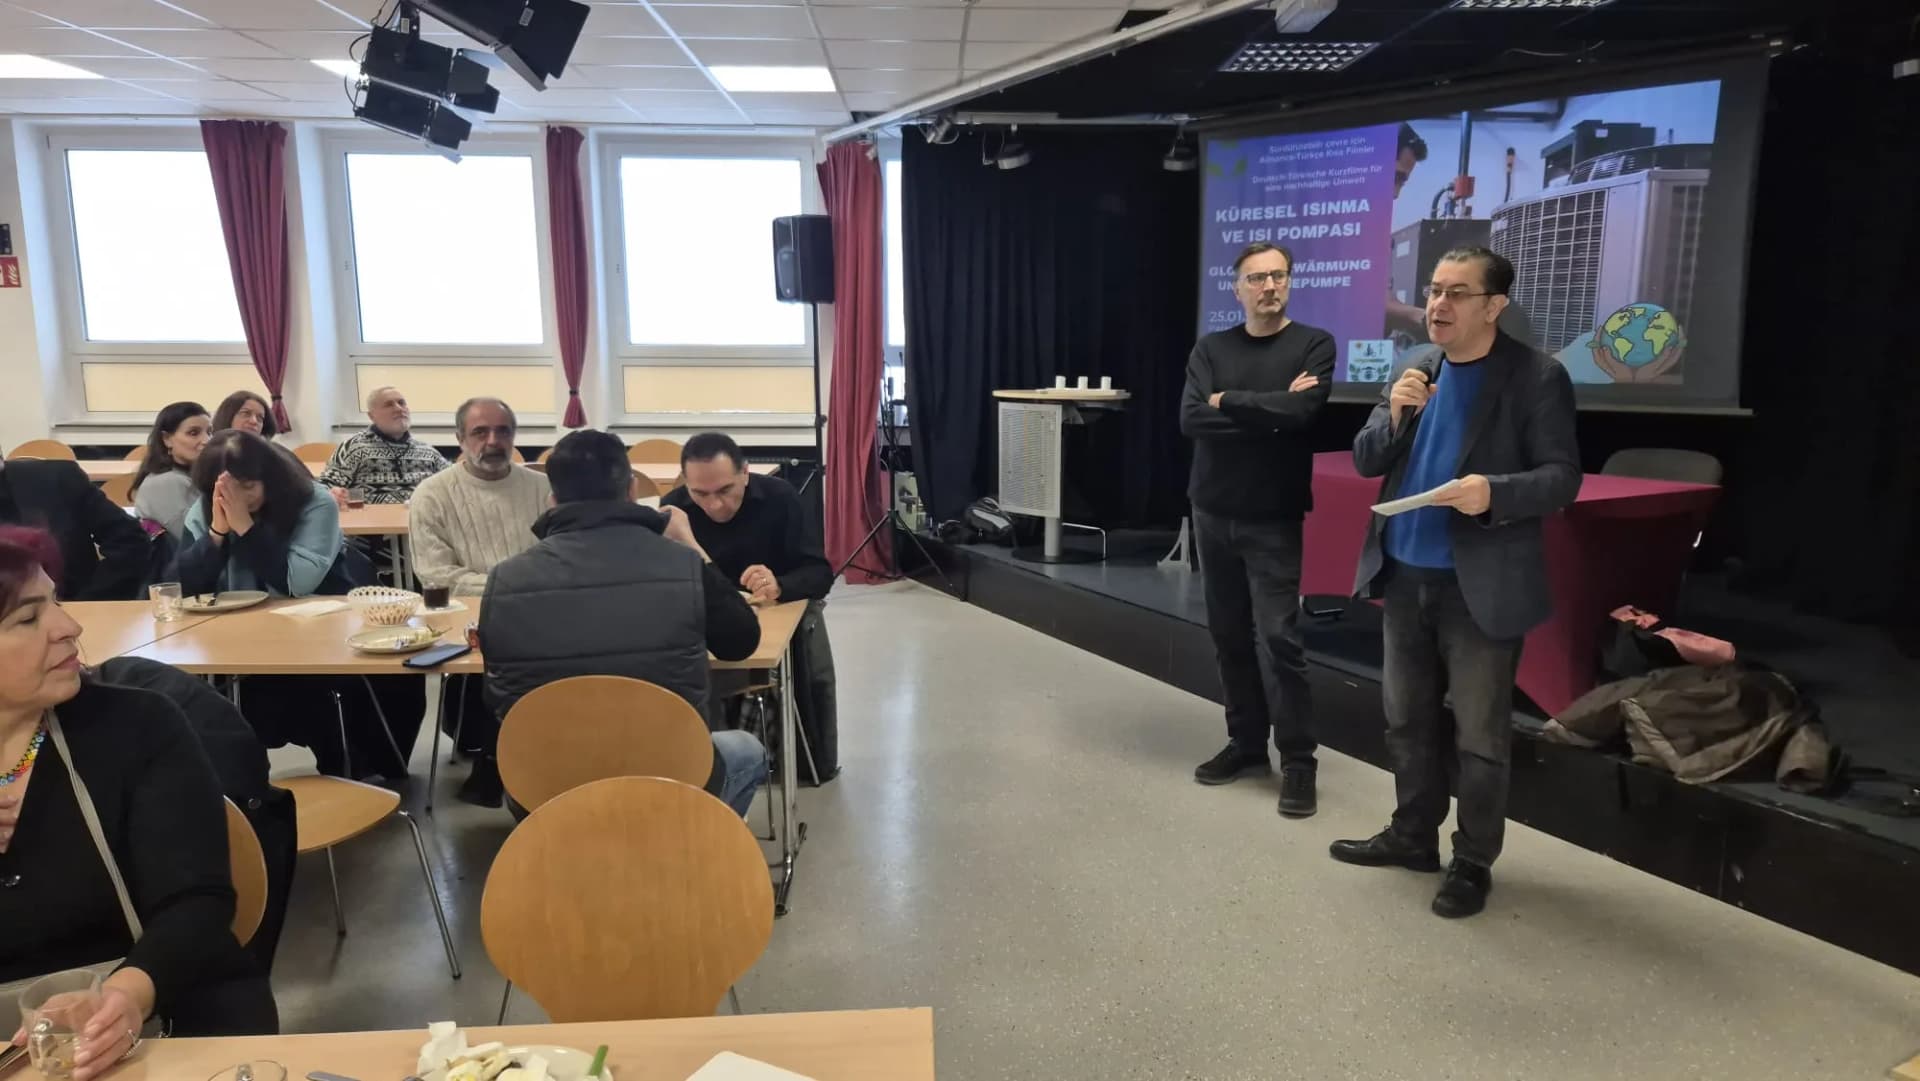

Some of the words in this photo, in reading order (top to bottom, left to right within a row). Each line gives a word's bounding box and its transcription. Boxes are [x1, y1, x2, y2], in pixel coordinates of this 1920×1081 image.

[1328, 167, 1368, 176] Kurzfilme
[1370, 165, 1383, 173] für
[1333, 176, 1365, 186] Umwelt
[1215, 204, 1297, 222] KÜRESEL
[1303, 199, 1370, 217] ISINMA
[1222, 230, 1244, 243] VE
[1249, 228, 1271, 241] ISI
[1277, 222, 1361, 241] POMPASI
[1293, 259, 1371, 273] WÄRMUNG
[1288, 276, 1352, 289] EPUMPE
